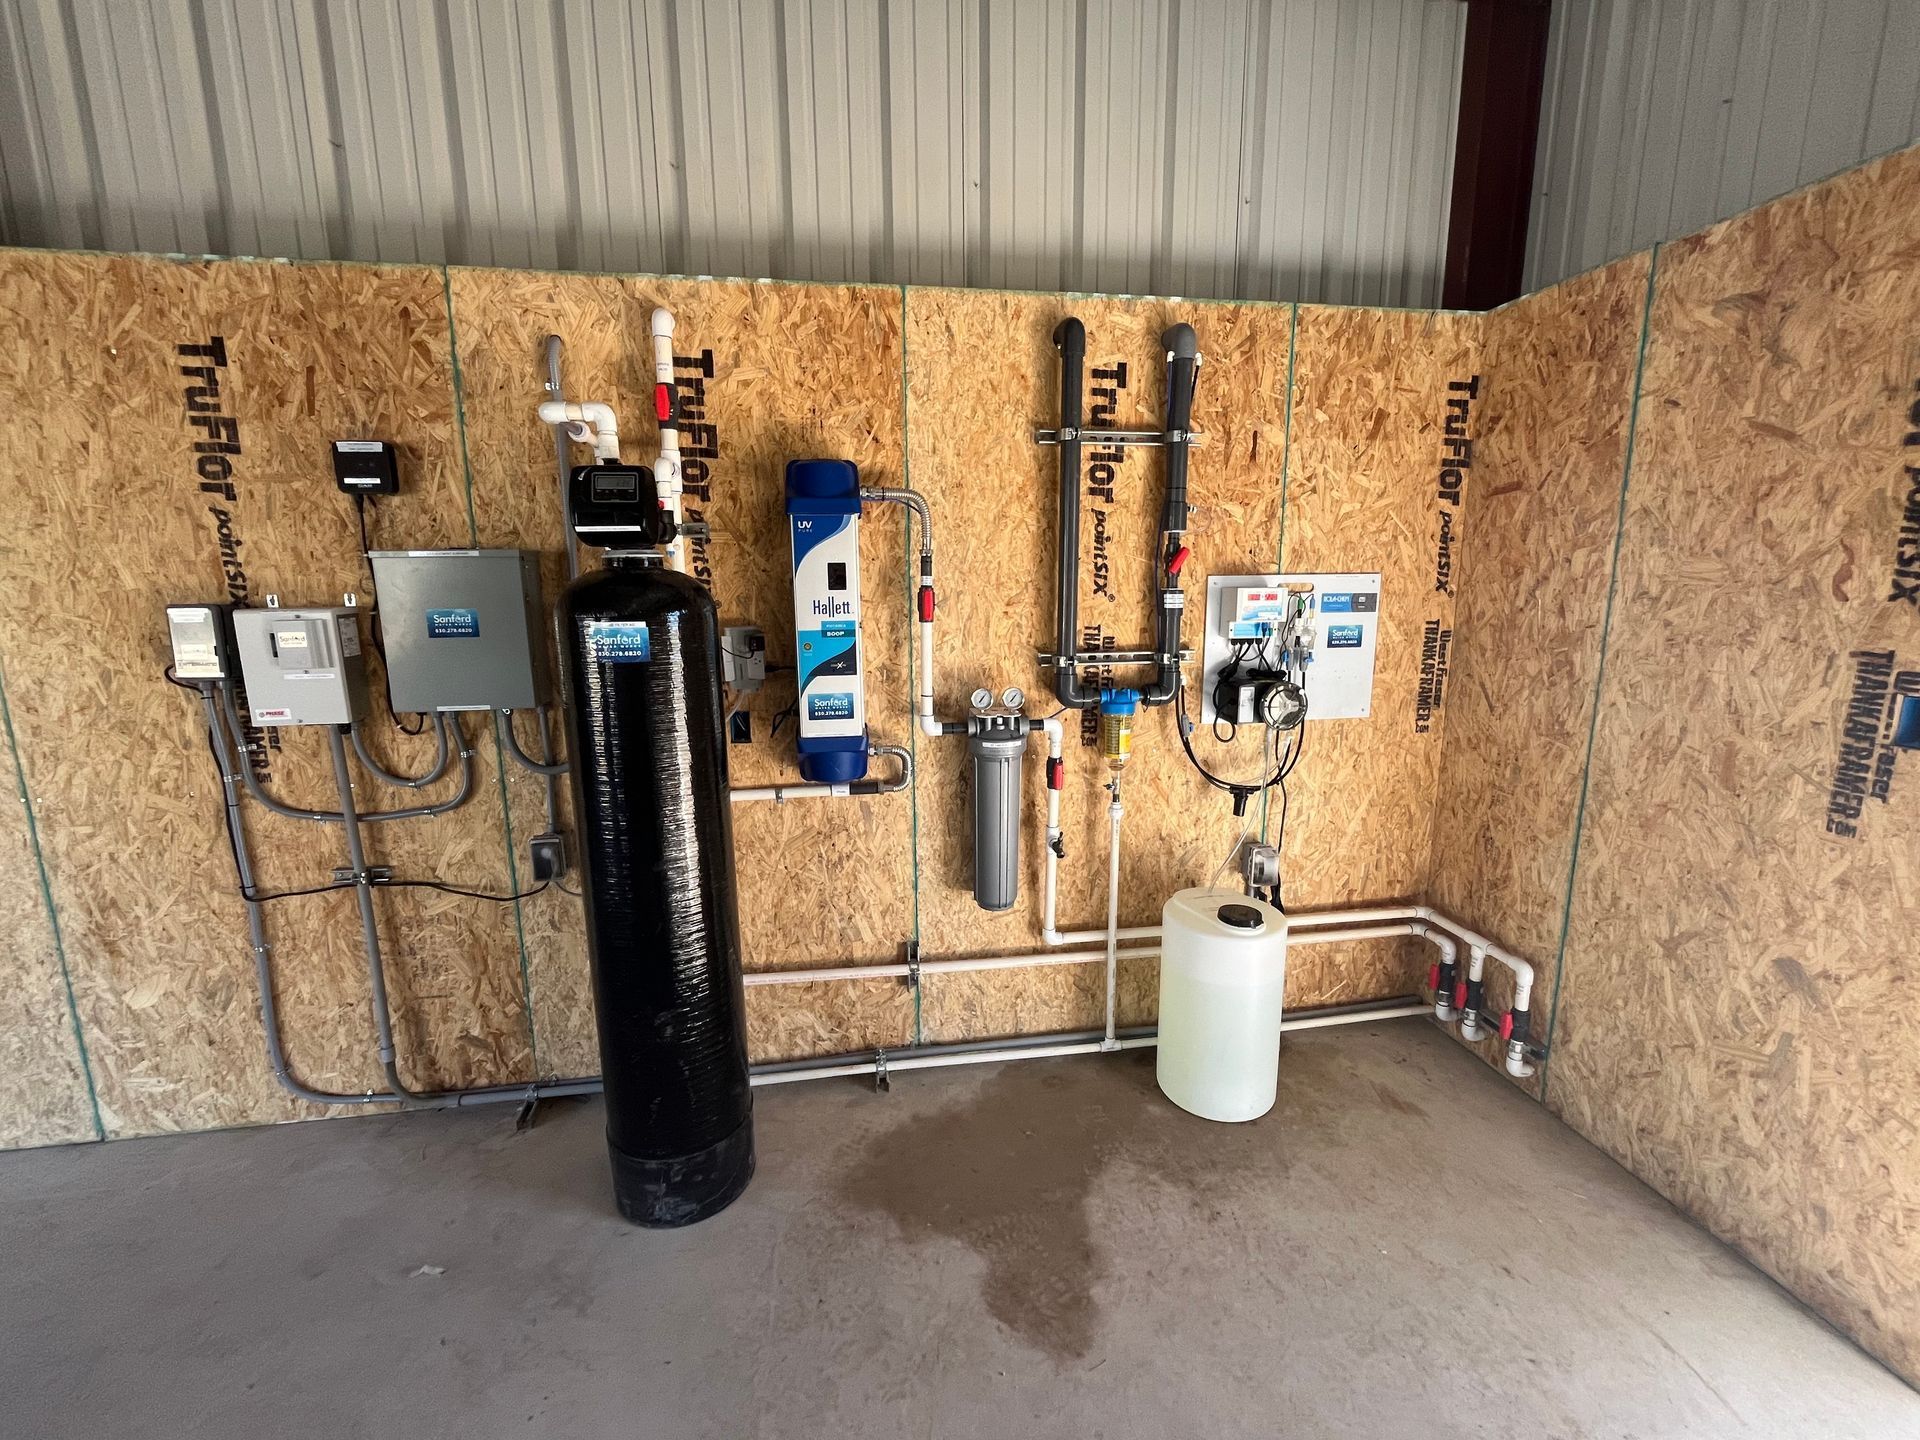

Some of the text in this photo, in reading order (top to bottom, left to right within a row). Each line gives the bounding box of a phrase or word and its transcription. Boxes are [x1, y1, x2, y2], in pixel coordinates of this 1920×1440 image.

[177, 336, 241, 501] TruFlor
[673, 349, 718, 502] TruFlor
[1438, 375, 1479, 506] TruFlor
[813, 596, 850, 617] Hallett
[433, 614, 472, 623] Sanford
[597, 633, 640, 645] Sanford
[1333, 629, 1359, 637] Sanford
[814, 698, 848, 706] Sanford
